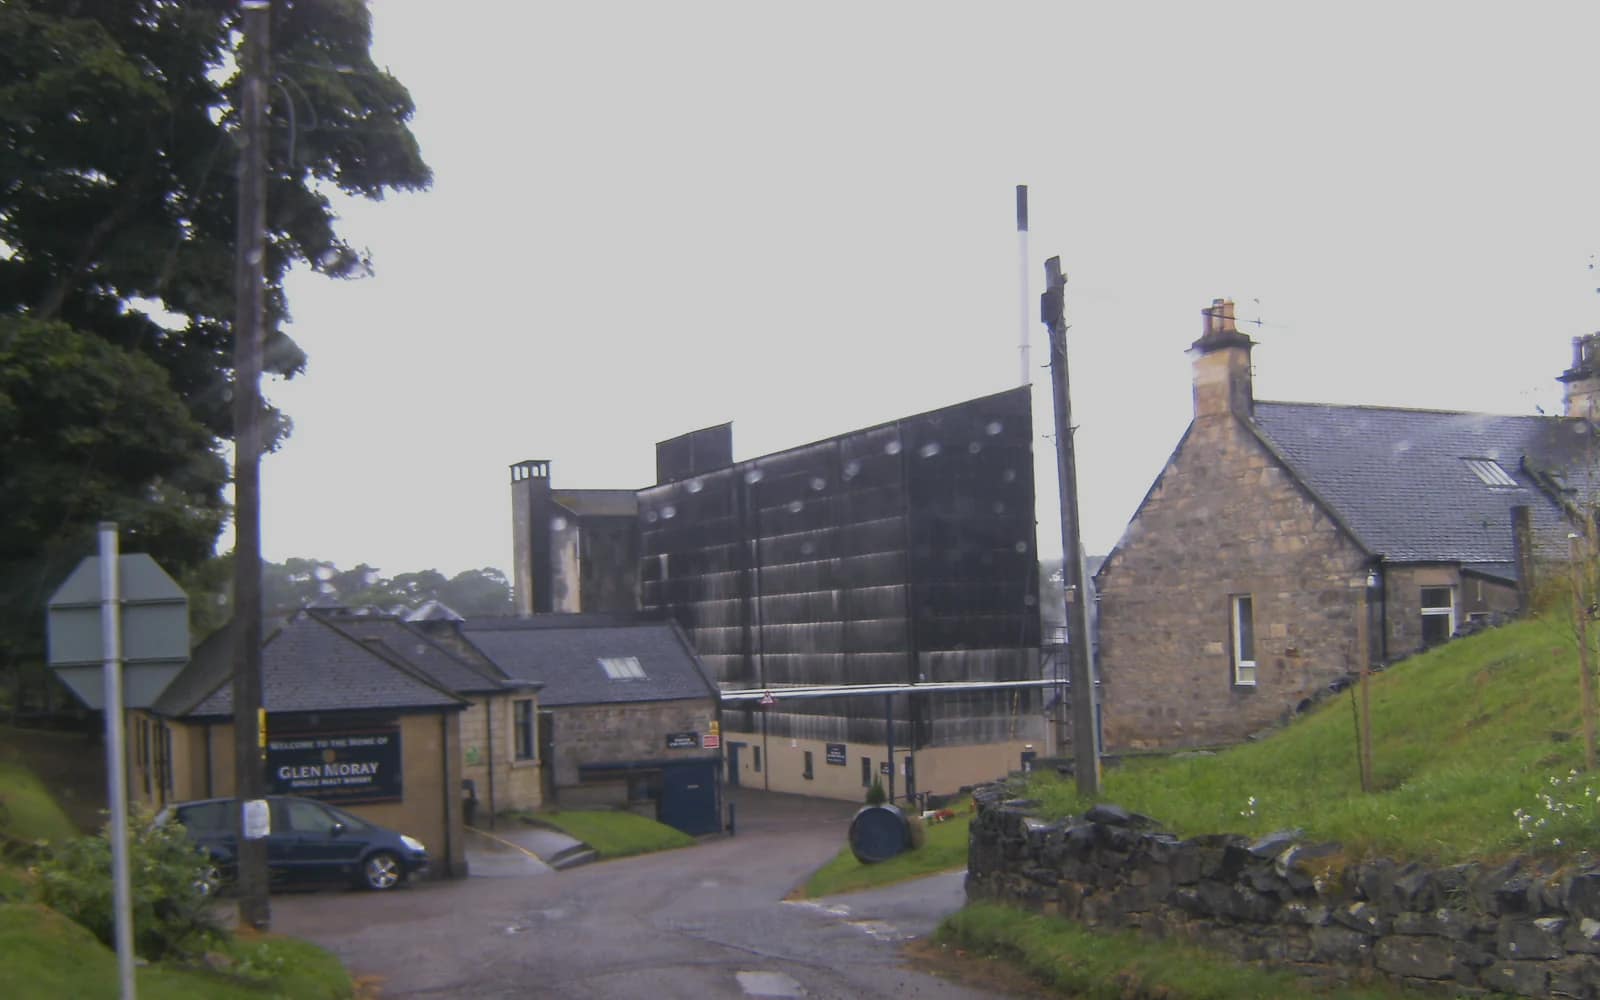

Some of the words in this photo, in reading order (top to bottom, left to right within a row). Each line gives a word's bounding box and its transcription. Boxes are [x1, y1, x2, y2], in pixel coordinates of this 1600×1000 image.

[270, 741, 314, 750] WELCOME
[316, 740, 329, 748] TO
[331, 739, 347, 747] THE
[348, 738, 375, 746] HOME
[376, 737, 388, 745] OF
[279, 765, 320, 779] GLEN
[324, 763, 378, 776] MORAY
